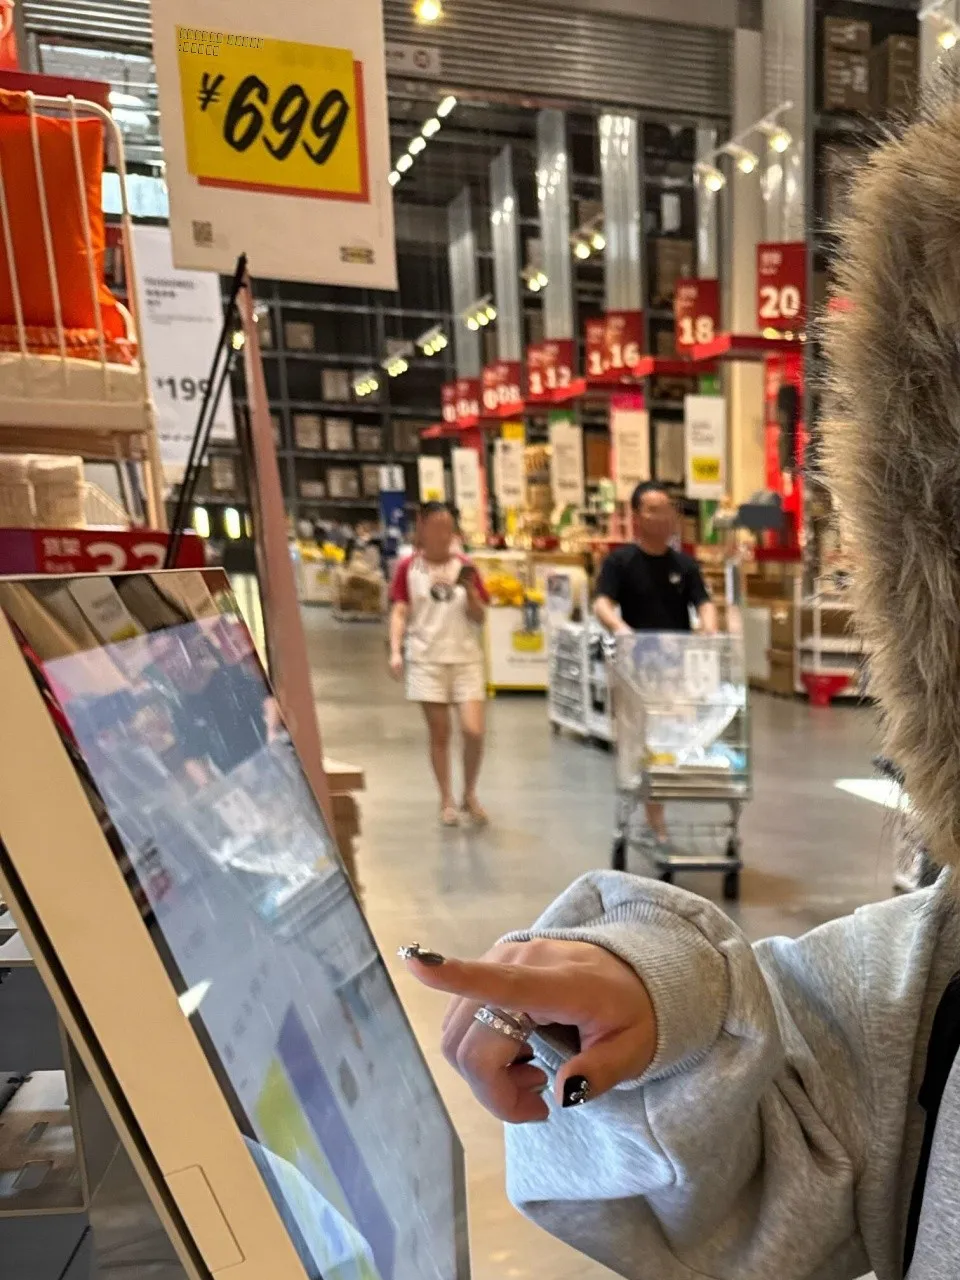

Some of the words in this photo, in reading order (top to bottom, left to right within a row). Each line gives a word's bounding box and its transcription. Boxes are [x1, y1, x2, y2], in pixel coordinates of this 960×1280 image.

[197, 71, 350, 166] ¥699
[759, 285, 800, 318] 20
[679, 315, 714, 345] 18
[610, 343, 641, 368] 16
